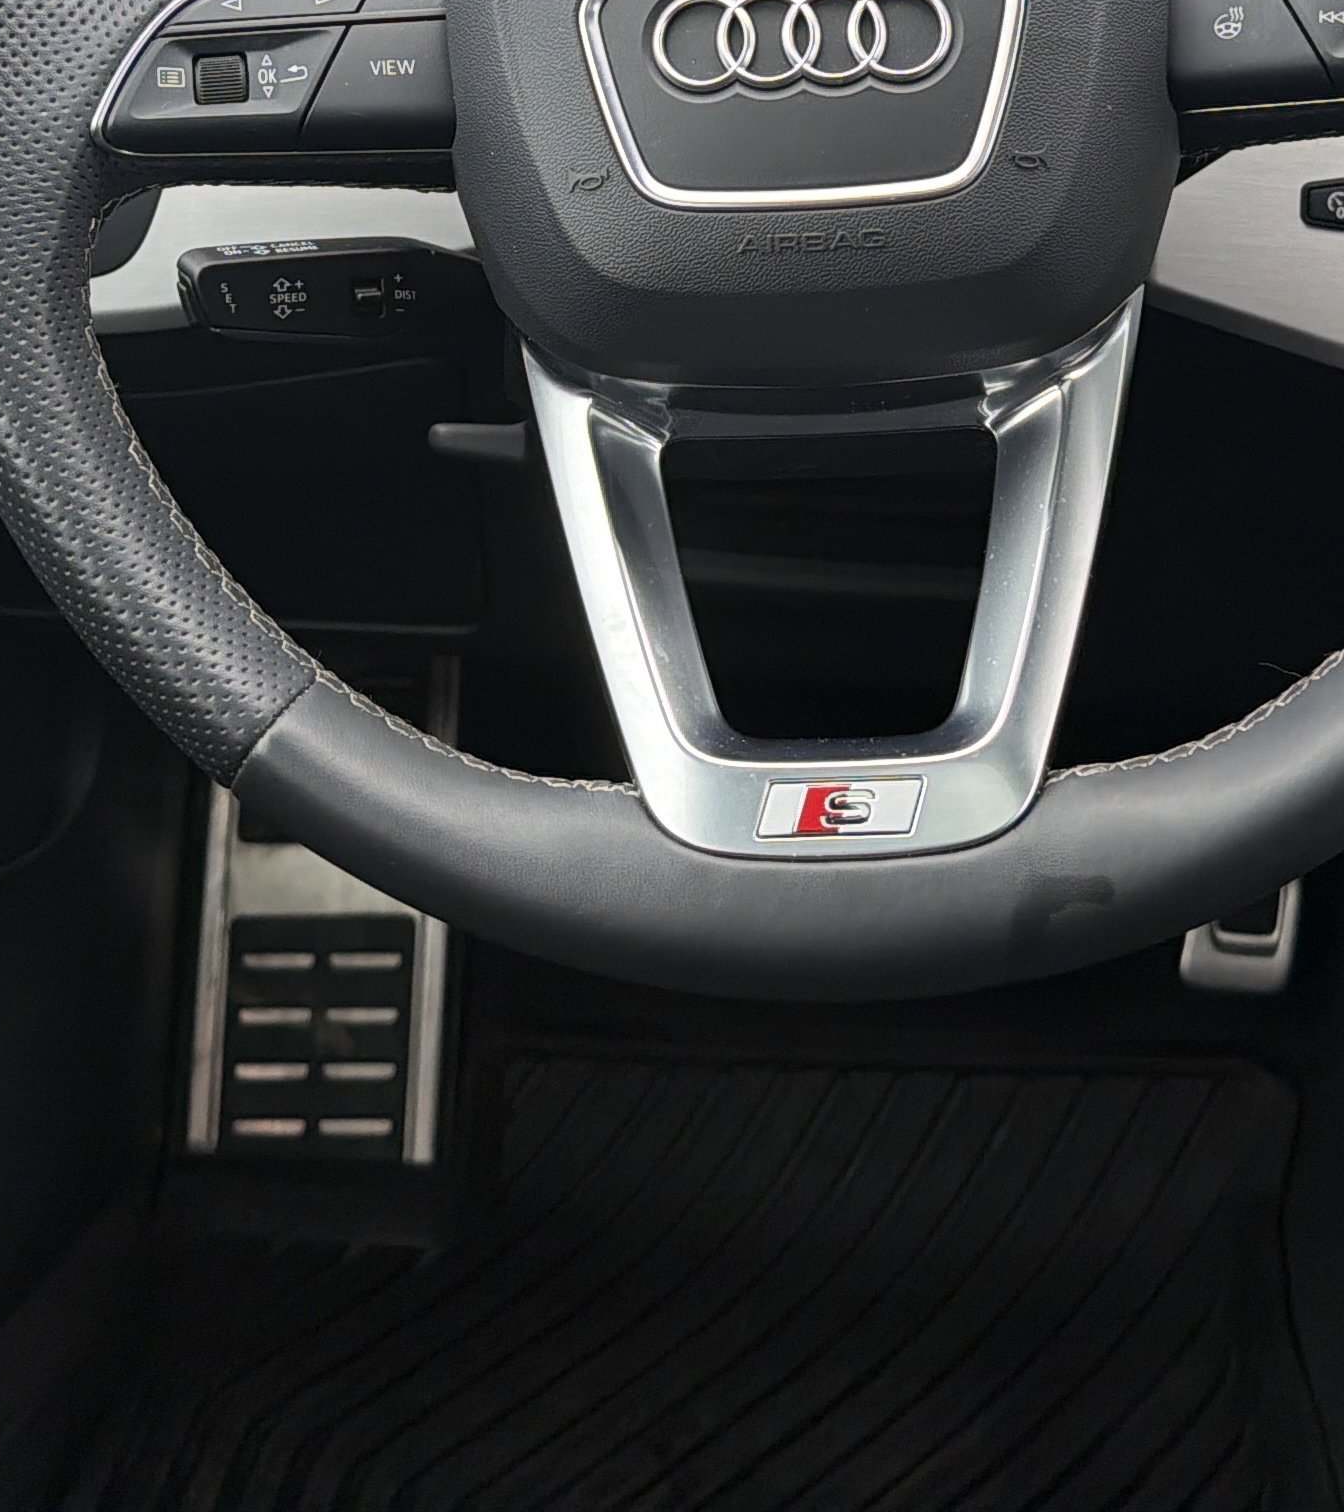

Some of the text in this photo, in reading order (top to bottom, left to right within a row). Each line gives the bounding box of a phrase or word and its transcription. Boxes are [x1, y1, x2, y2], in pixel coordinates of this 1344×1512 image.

[258, 68, 276, 84] OK
[369, 60, 416, 76] VIEW
[736, 228, 886, 254] AIRBAG
[269, 292, 307, 304] SPEED
[395, 290, 416, 300] DIST
